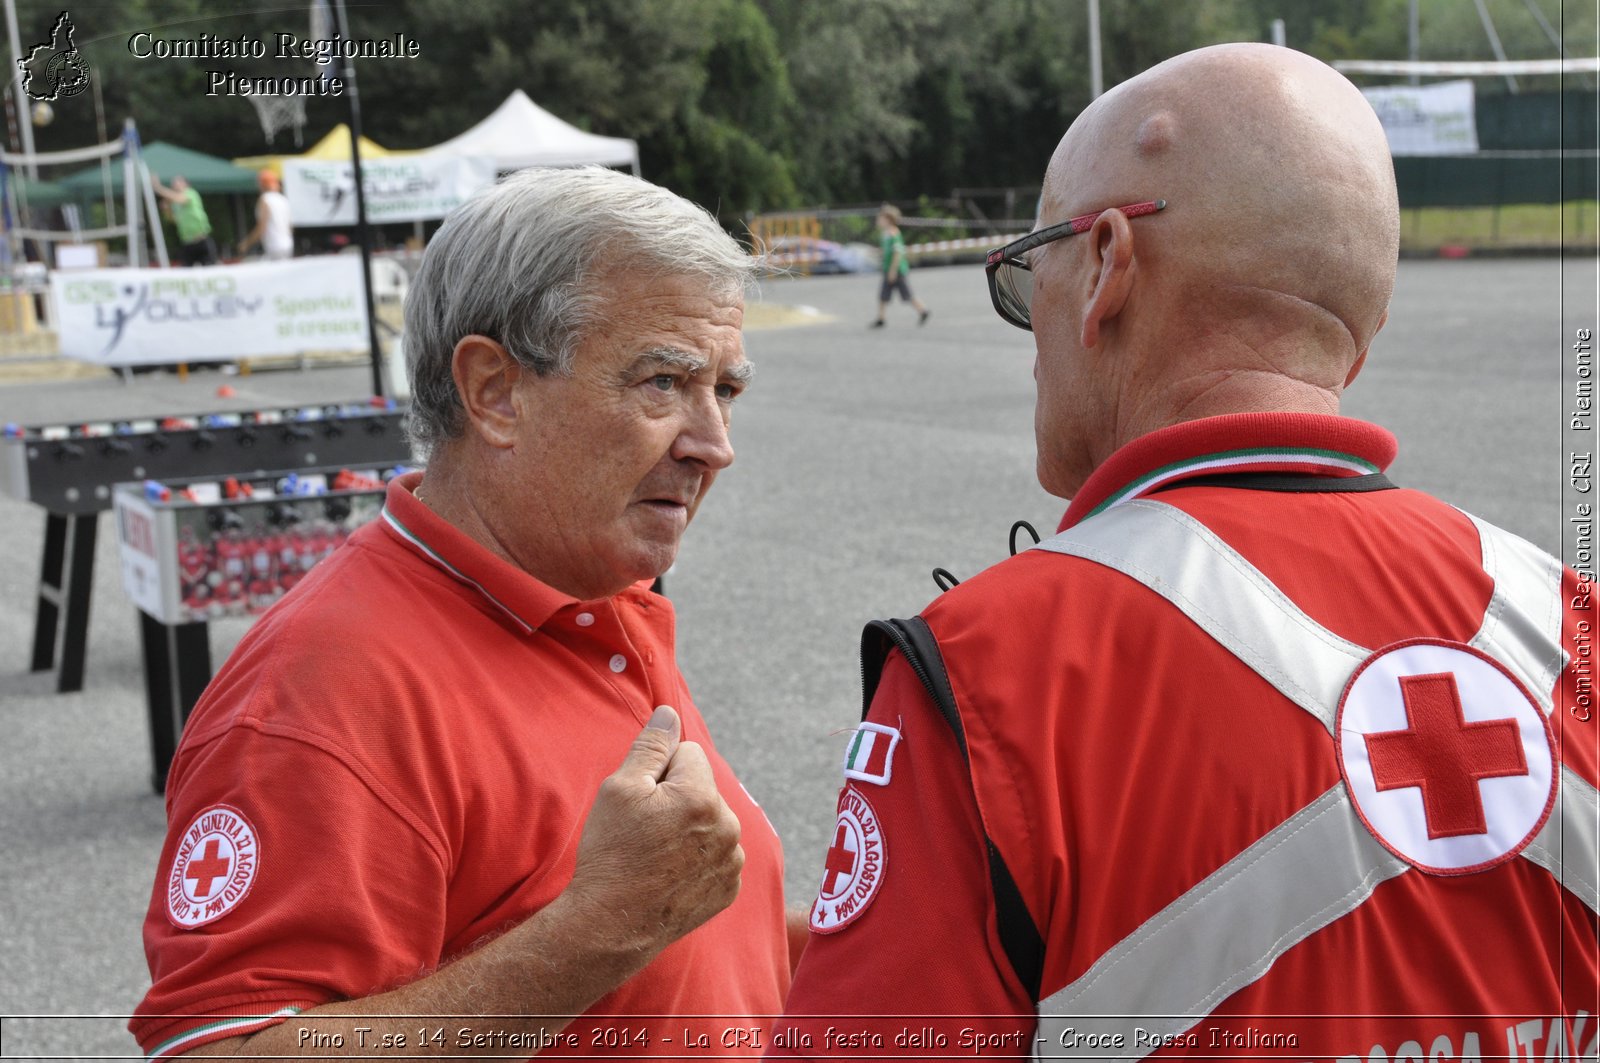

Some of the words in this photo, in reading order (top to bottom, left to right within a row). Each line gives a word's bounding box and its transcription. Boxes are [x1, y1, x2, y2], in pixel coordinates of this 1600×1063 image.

[190, 826, 201, 843] DI
[201, 814, 244, 840] GINEVRA
[860, 818, 876, 838] 22
[224, 853, 253, 902] AGOSTO
[858, 838, 880, 901] AGOSTO
[205, 898, 225, 918] 1864
[835, 892, 859, 922] 1864
